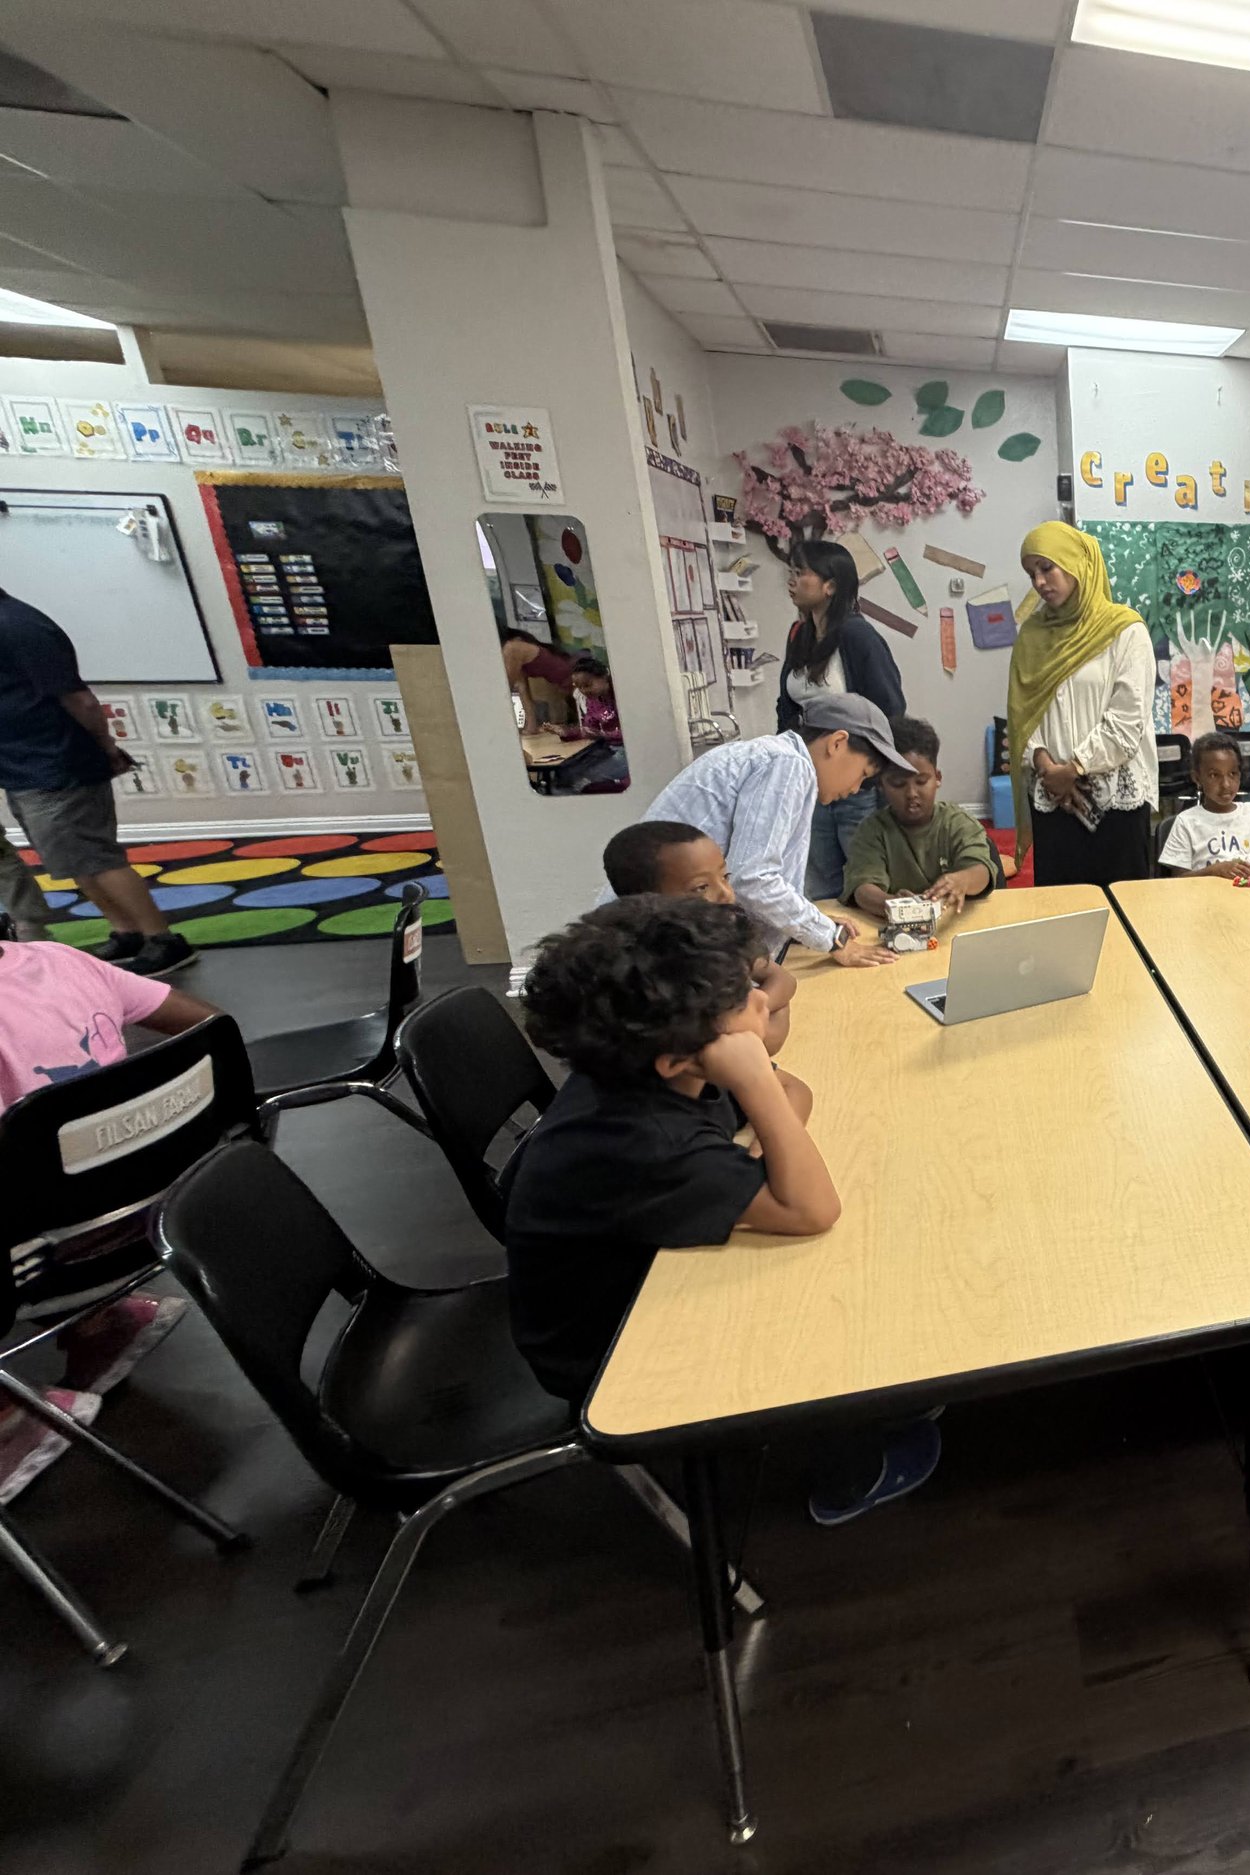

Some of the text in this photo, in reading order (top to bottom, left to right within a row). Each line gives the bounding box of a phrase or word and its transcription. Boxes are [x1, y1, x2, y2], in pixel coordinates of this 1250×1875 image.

[131, 421, 160, 443] Pp
[237, 428, 267, 446] Rr
[488, 440, 543, 452] WALKING
[96, 1105, 159, 1150] FILSAN
